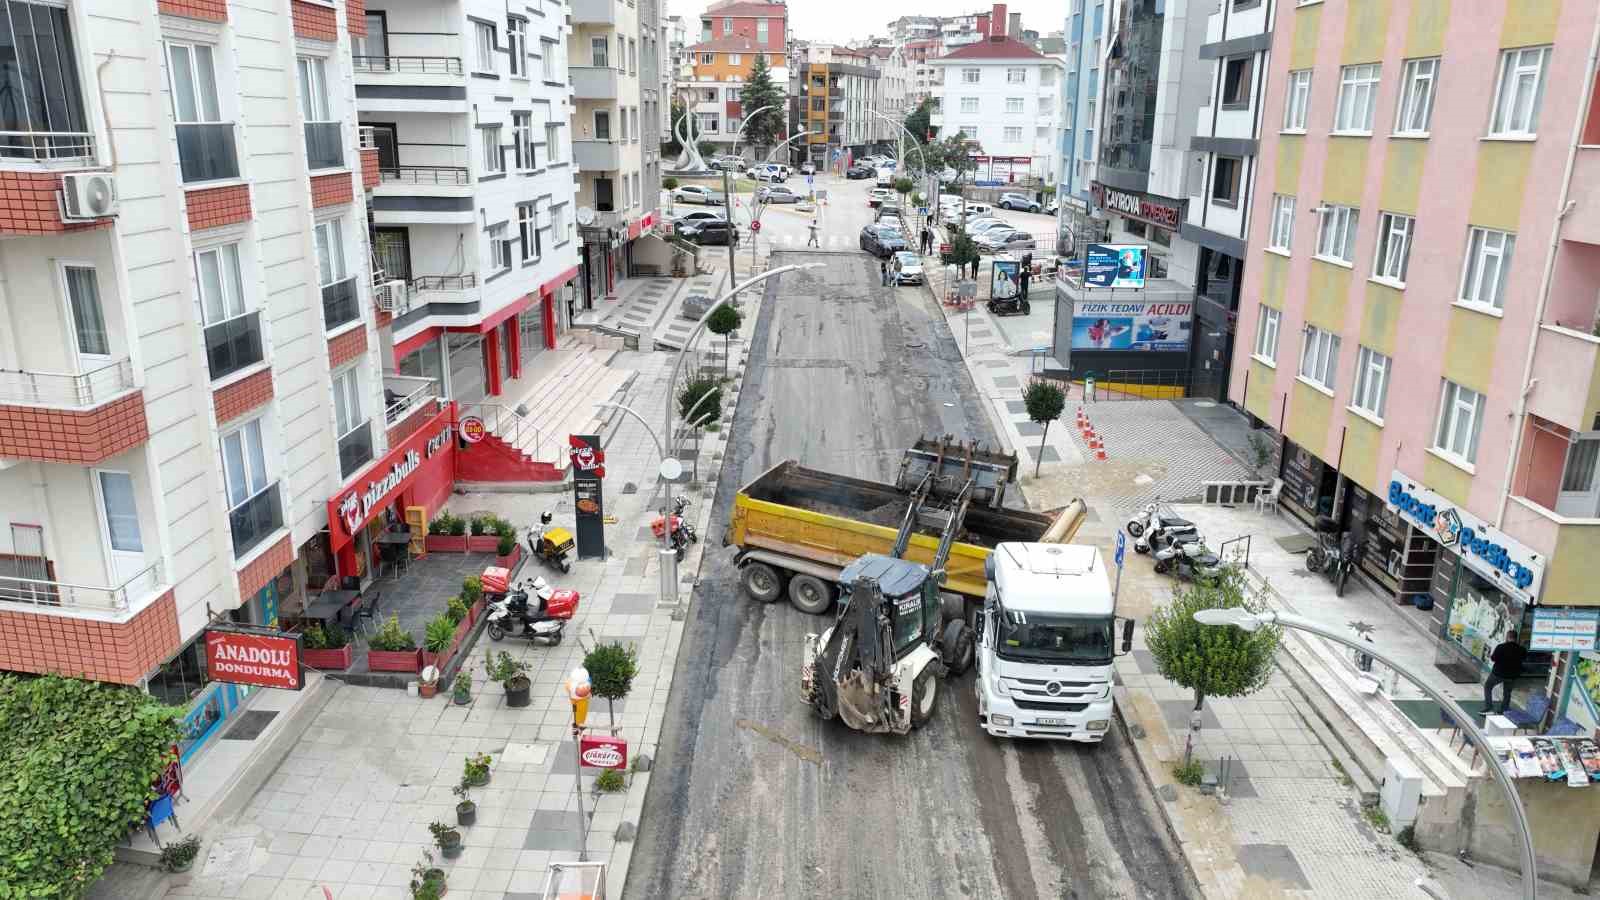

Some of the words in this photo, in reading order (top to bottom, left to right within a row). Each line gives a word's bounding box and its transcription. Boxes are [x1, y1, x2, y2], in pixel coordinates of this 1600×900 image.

[363, 449, 420, 518] pizzabulls
[215, 643, 290, 666] ANADOLU
[215, 662, 292, 679] DONDURMA
